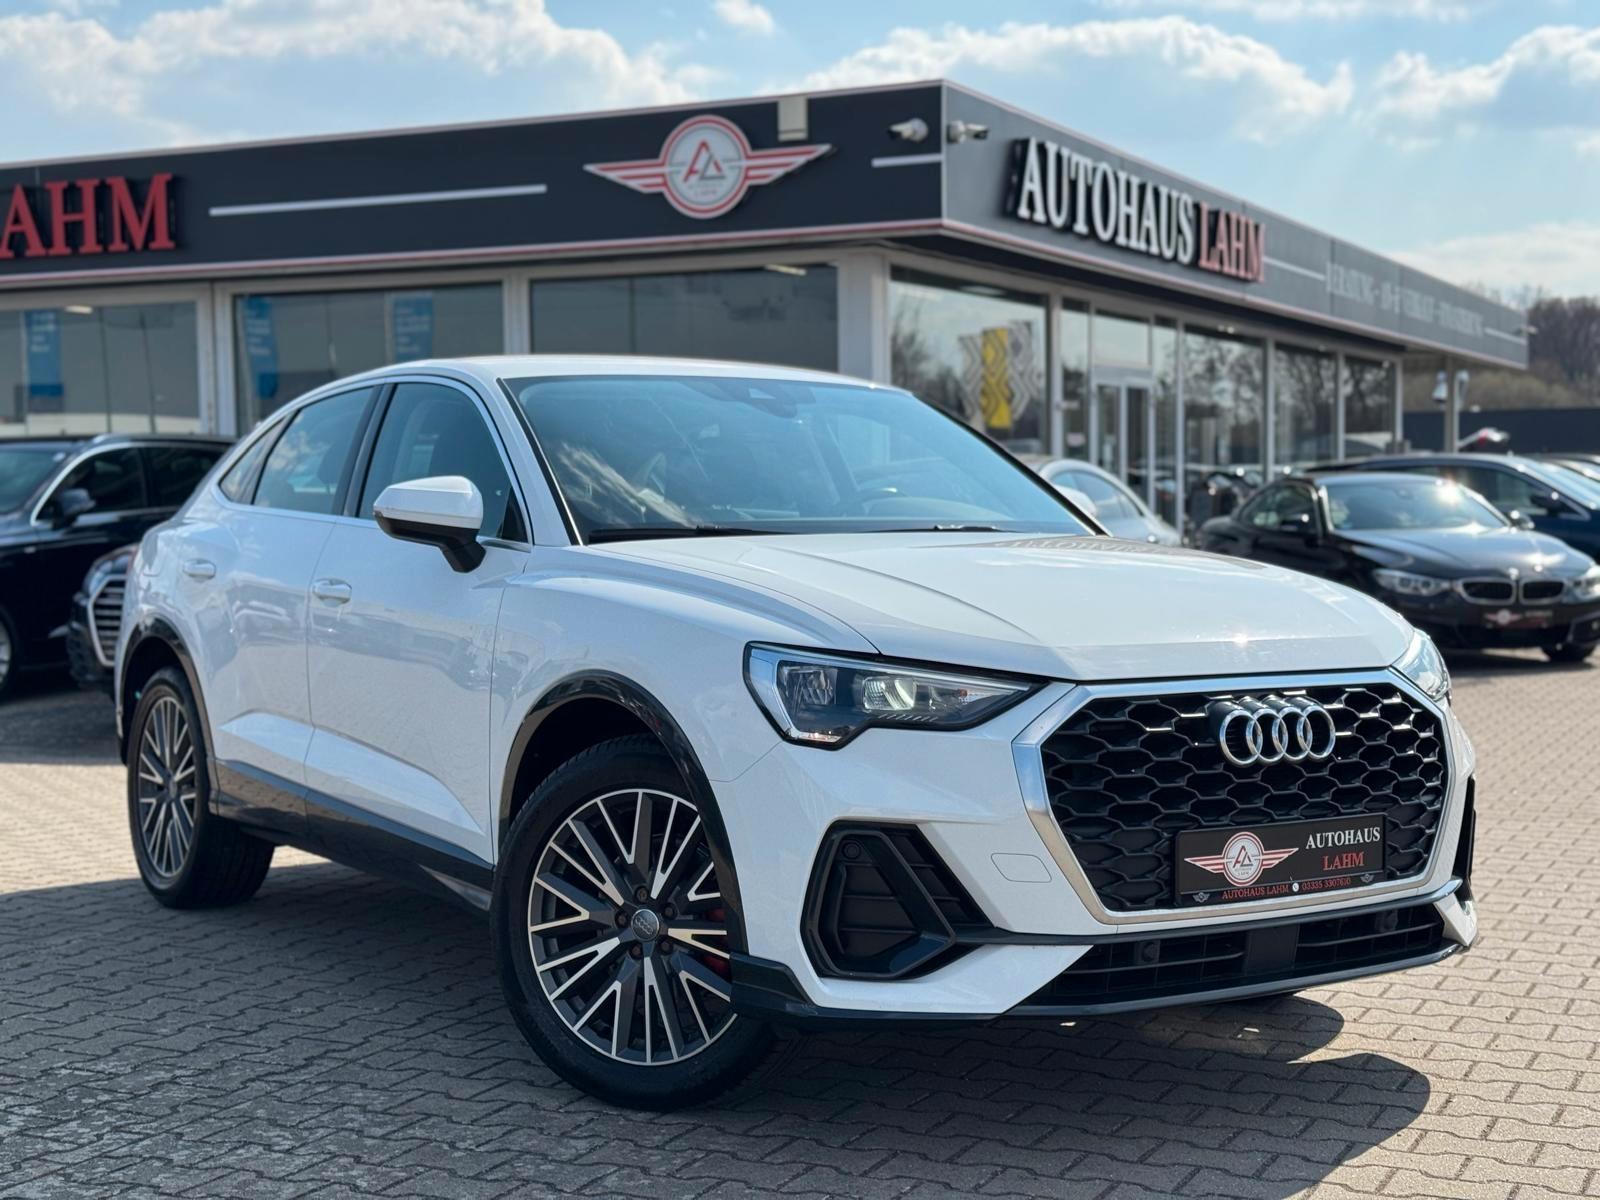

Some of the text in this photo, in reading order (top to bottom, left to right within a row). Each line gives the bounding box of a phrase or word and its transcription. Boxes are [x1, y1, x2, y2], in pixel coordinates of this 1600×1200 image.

[1017, 137, 1266, 283] AUTOHAUS LAHM
[1306, 827, 1381, 871] AUTOHAUS LAHM
[1222, 887, 1265, 899] AUTOHAUS
[1267, 884, 1289, 895] LAHM
[1301, 880, 1323, 891] 03335
